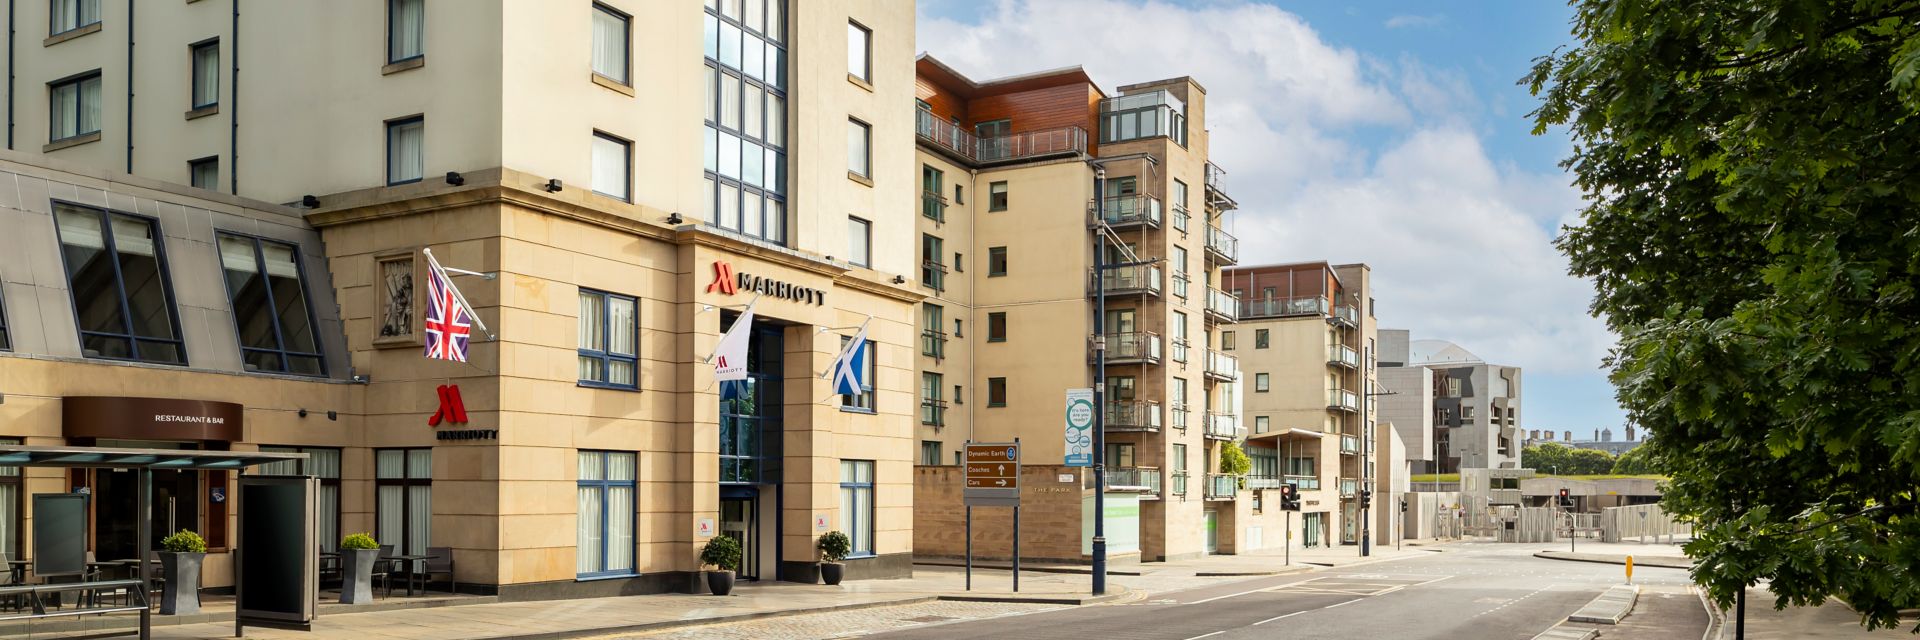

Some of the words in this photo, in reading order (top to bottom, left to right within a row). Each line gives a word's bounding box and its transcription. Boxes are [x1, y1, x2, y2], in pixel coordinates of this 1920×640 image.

[738, 272, 827, 306] MARRIOTT
[155, 414, 206, 423] RESTAURANT
[968, 450, 990, 458] Dynamic
